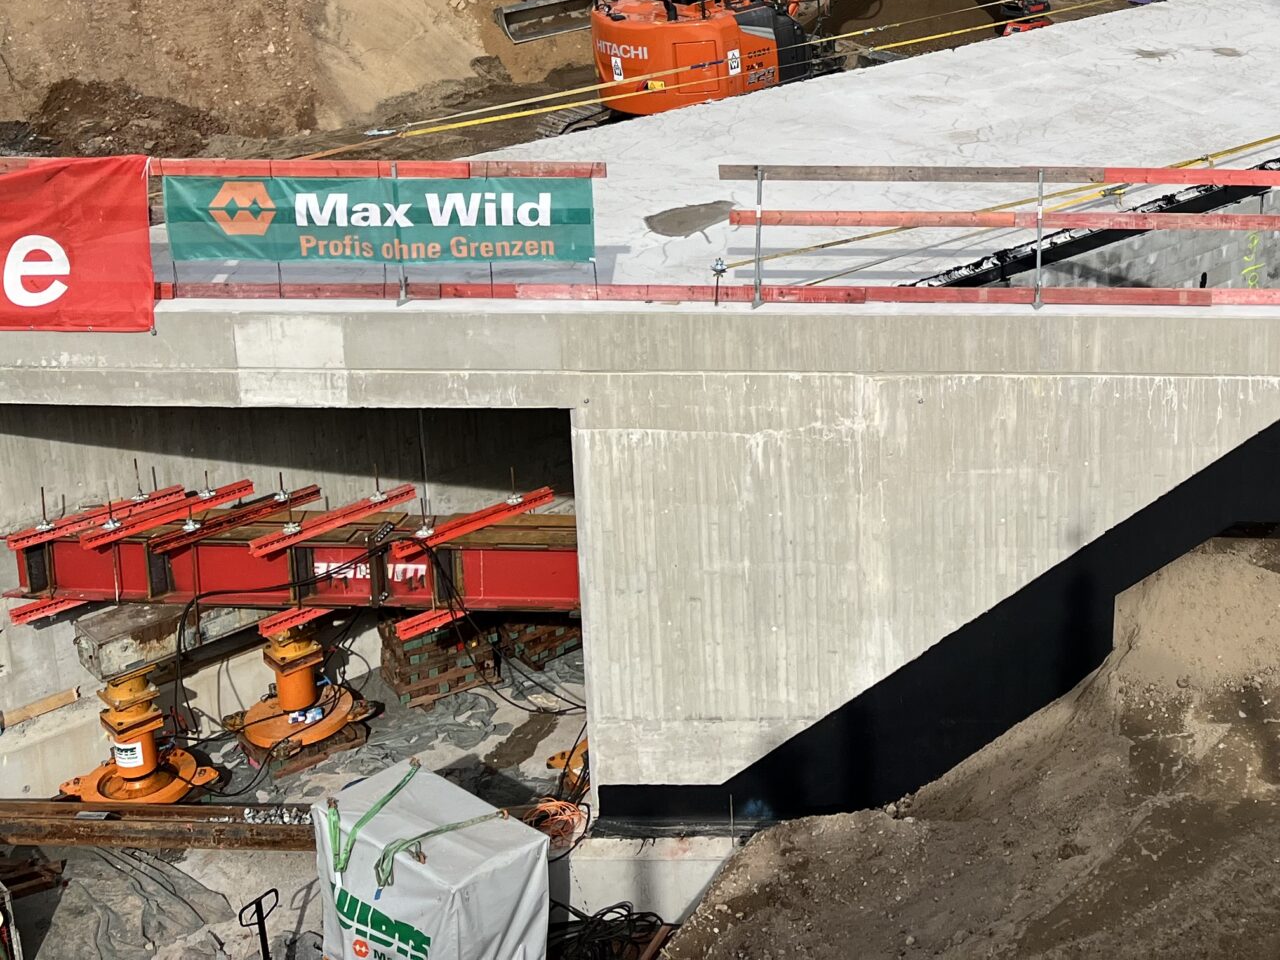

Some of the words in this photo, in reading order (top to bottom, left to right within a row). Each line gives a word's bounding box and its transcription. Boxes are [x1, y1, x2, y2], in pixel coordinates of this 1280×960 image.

[595, 39, 649, 60] HITACHI
[294, 193, 415, 228] Max
[424, 192, 551, 227] Wild
[299, 235, 374, 258] Profis
[381, 238, 442, 260] ohne
[449, 236, 555, 258] Grenzen
